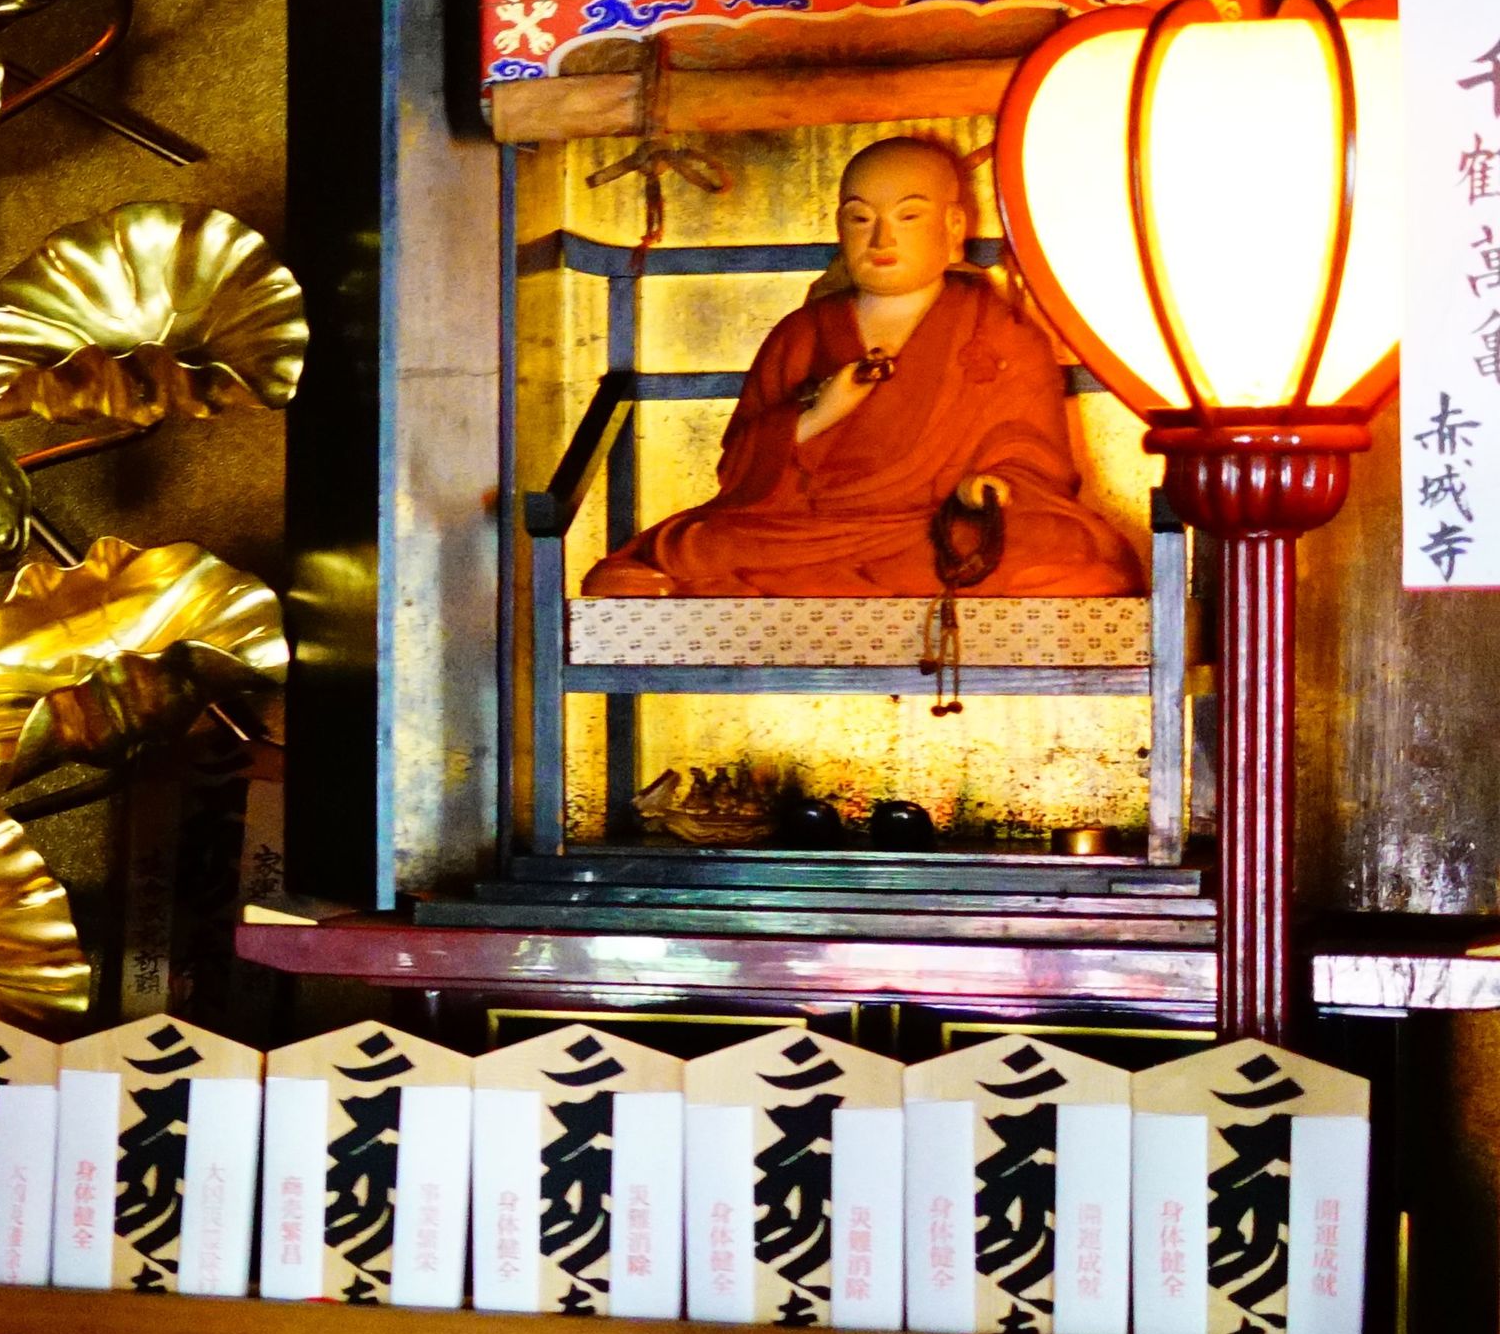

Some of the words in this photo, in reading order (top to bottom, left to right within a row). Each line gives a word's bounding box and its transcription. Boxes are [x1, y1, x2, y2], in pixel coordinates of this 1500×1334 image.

[1413, 392, 1481, 583] 赤城寺
[71, 1159, 97, 1252] 身体健全
[495, 1190, 522, 1285] 身体健全
[624, 1182, 653, 1279] 災難消除
[708, 1201, 736, 1298] 身体健全
[841, 1204, 875, 1304] 災難消除
[927, 1195, 957, 1293] 身体健全
[1156, 1199, 1188, 1301] 身体健全
[1310, 1197, 1341, 1299] 開運成就
